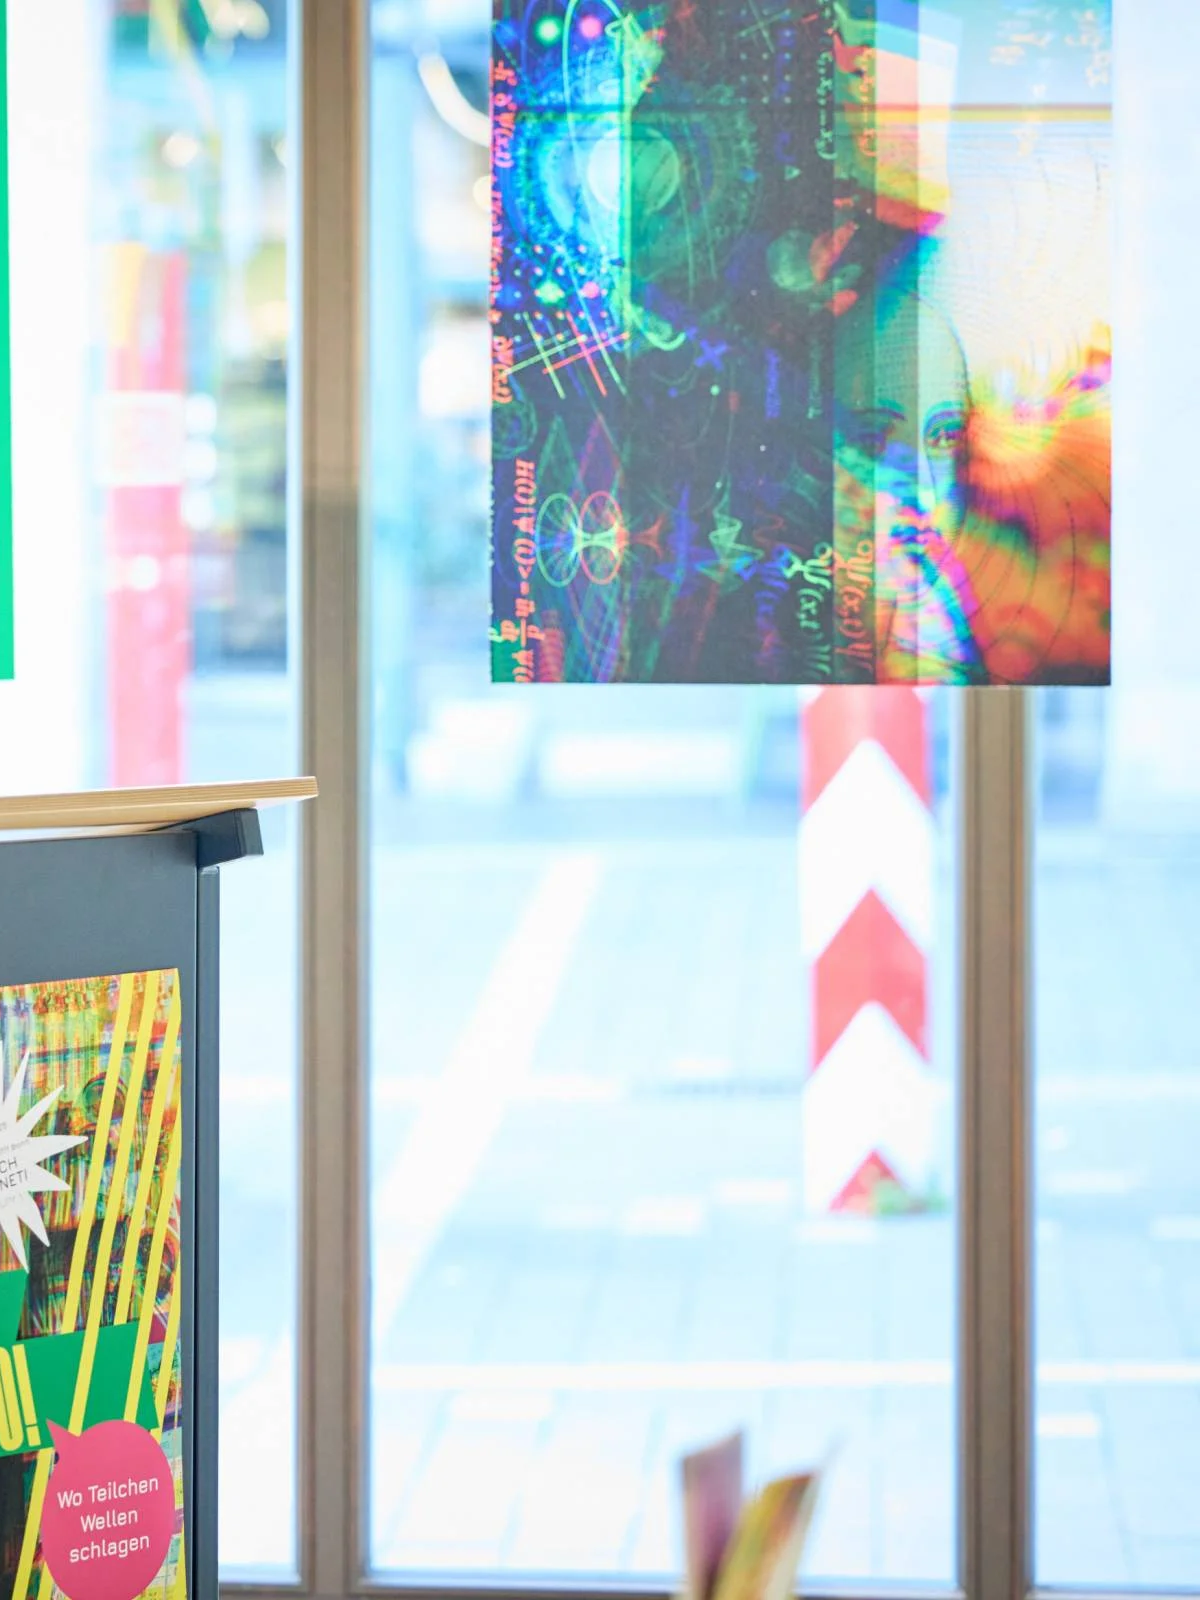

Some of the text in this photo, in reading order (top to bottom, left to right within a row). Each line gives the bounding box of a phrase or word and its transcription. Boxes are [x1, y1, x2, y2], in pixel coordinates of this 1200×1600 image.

[56, 1477, 159, 1509] Wo Teilchen
[80, 1509, 138, 1533] Wellen
[69, 1535, 150, 1564] schlagen
